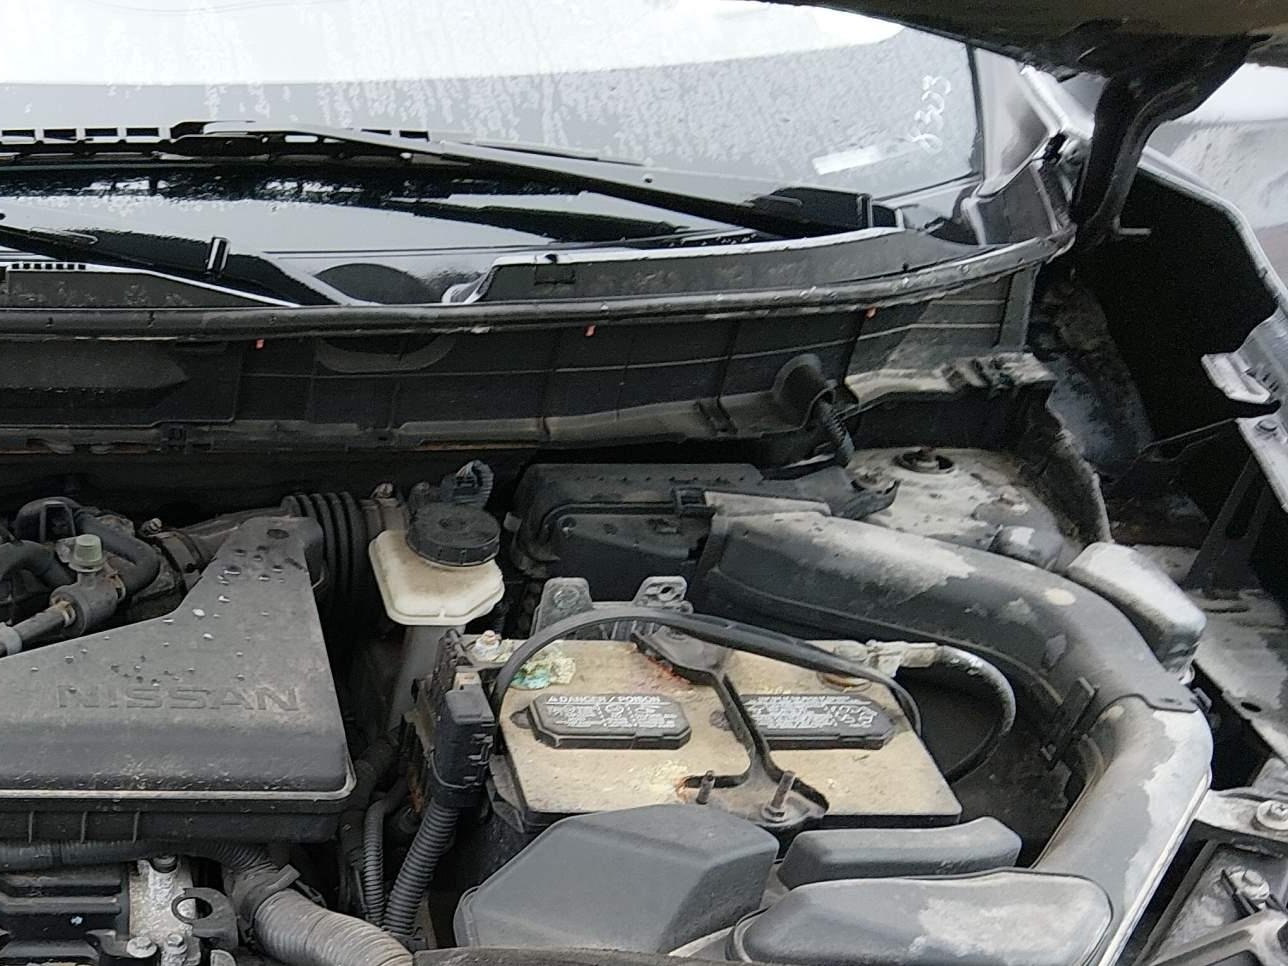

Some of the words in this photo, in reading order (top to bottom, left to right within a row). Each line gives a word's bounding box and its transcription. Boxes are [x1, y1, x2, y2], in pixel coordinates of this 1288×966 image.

[56, 684, 300, 711] NISSAN
[558, 695, 606, 704] DANGER
[617, 695, 661, 704] POISON
